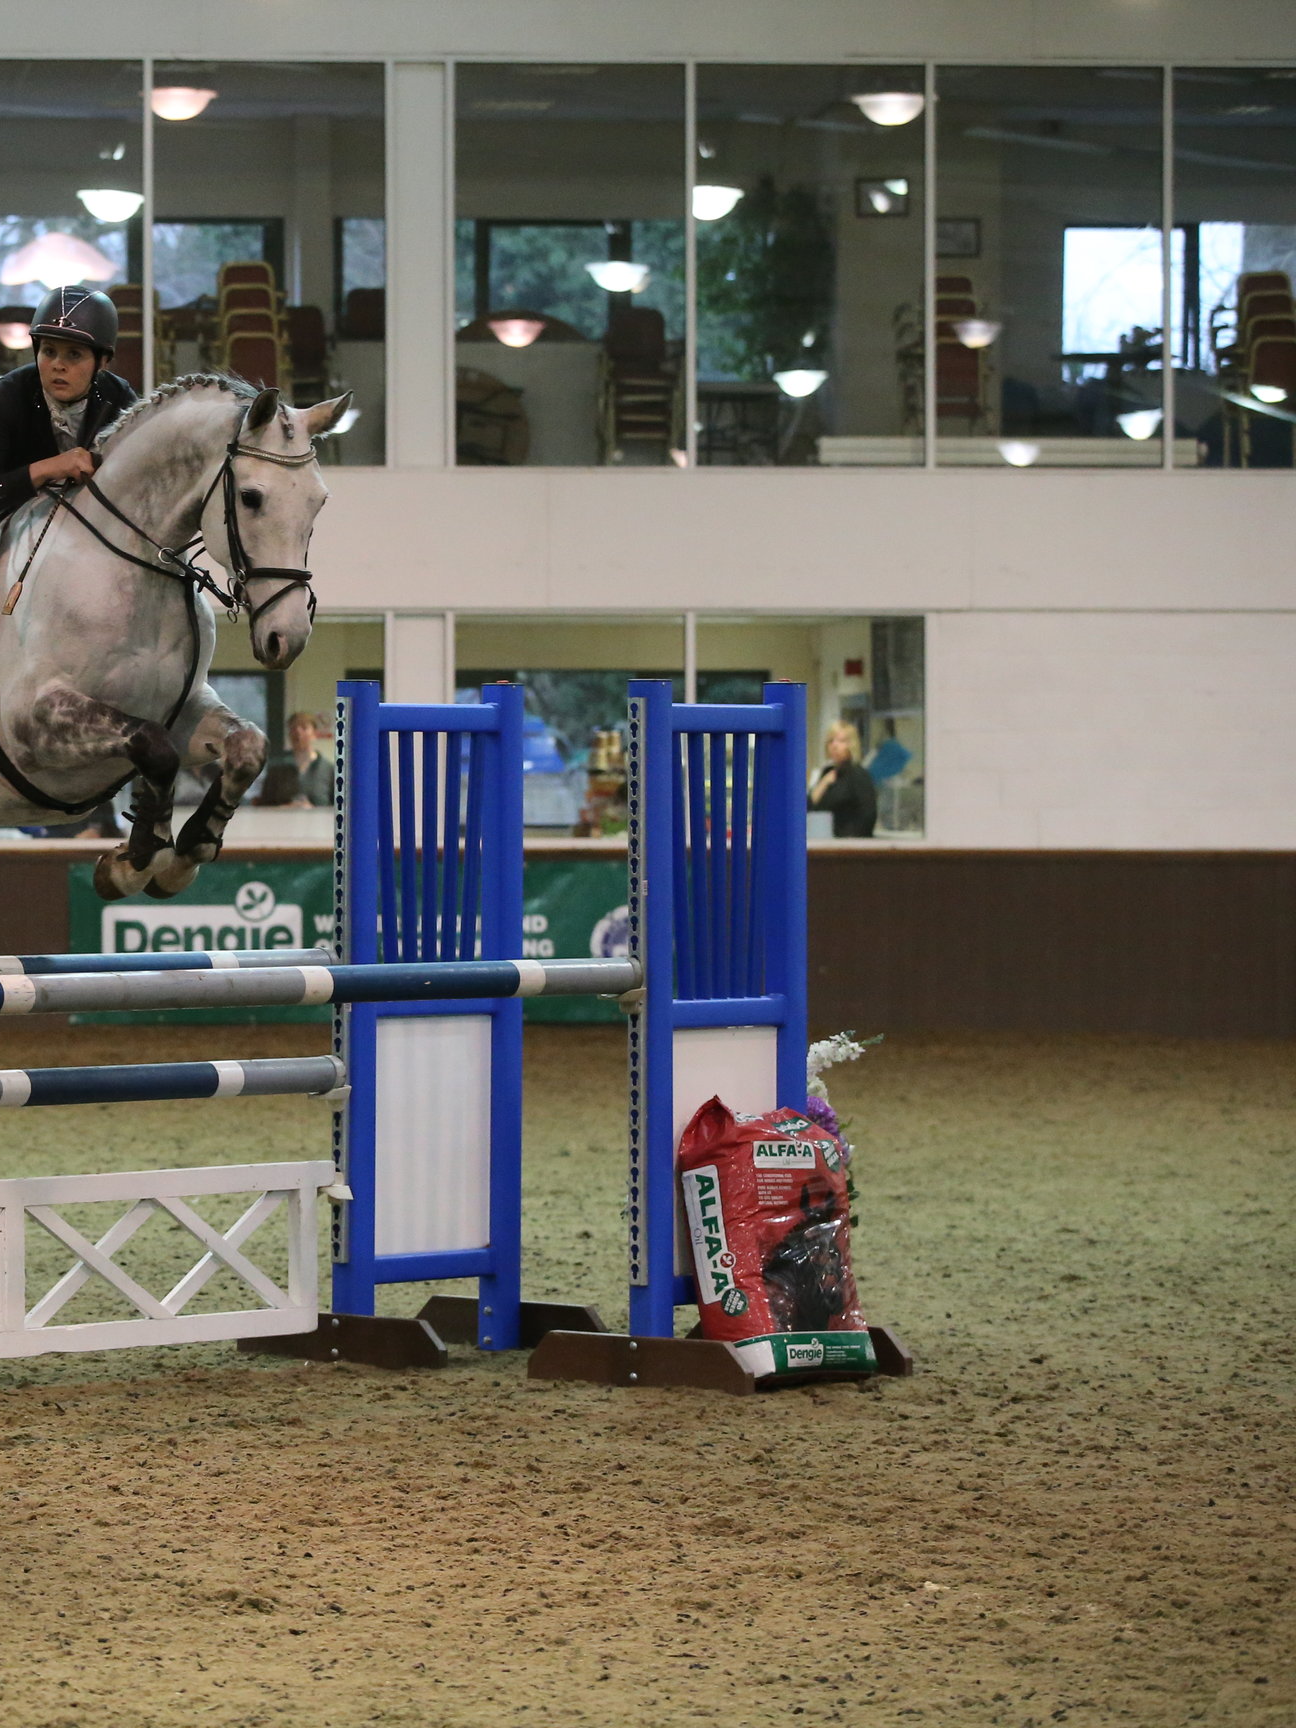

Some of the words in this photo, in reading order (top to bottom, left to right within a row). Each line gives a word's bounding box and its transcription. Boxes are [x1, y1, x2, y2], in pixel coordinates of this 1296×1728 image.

[756, 1144, 812, 1157] ALFA-A
[693, 1228, 703, 1245] Oil
[695, 1174, 729, 1295] ALFA-A
[789, 1348, 822, 1361] Dengie
